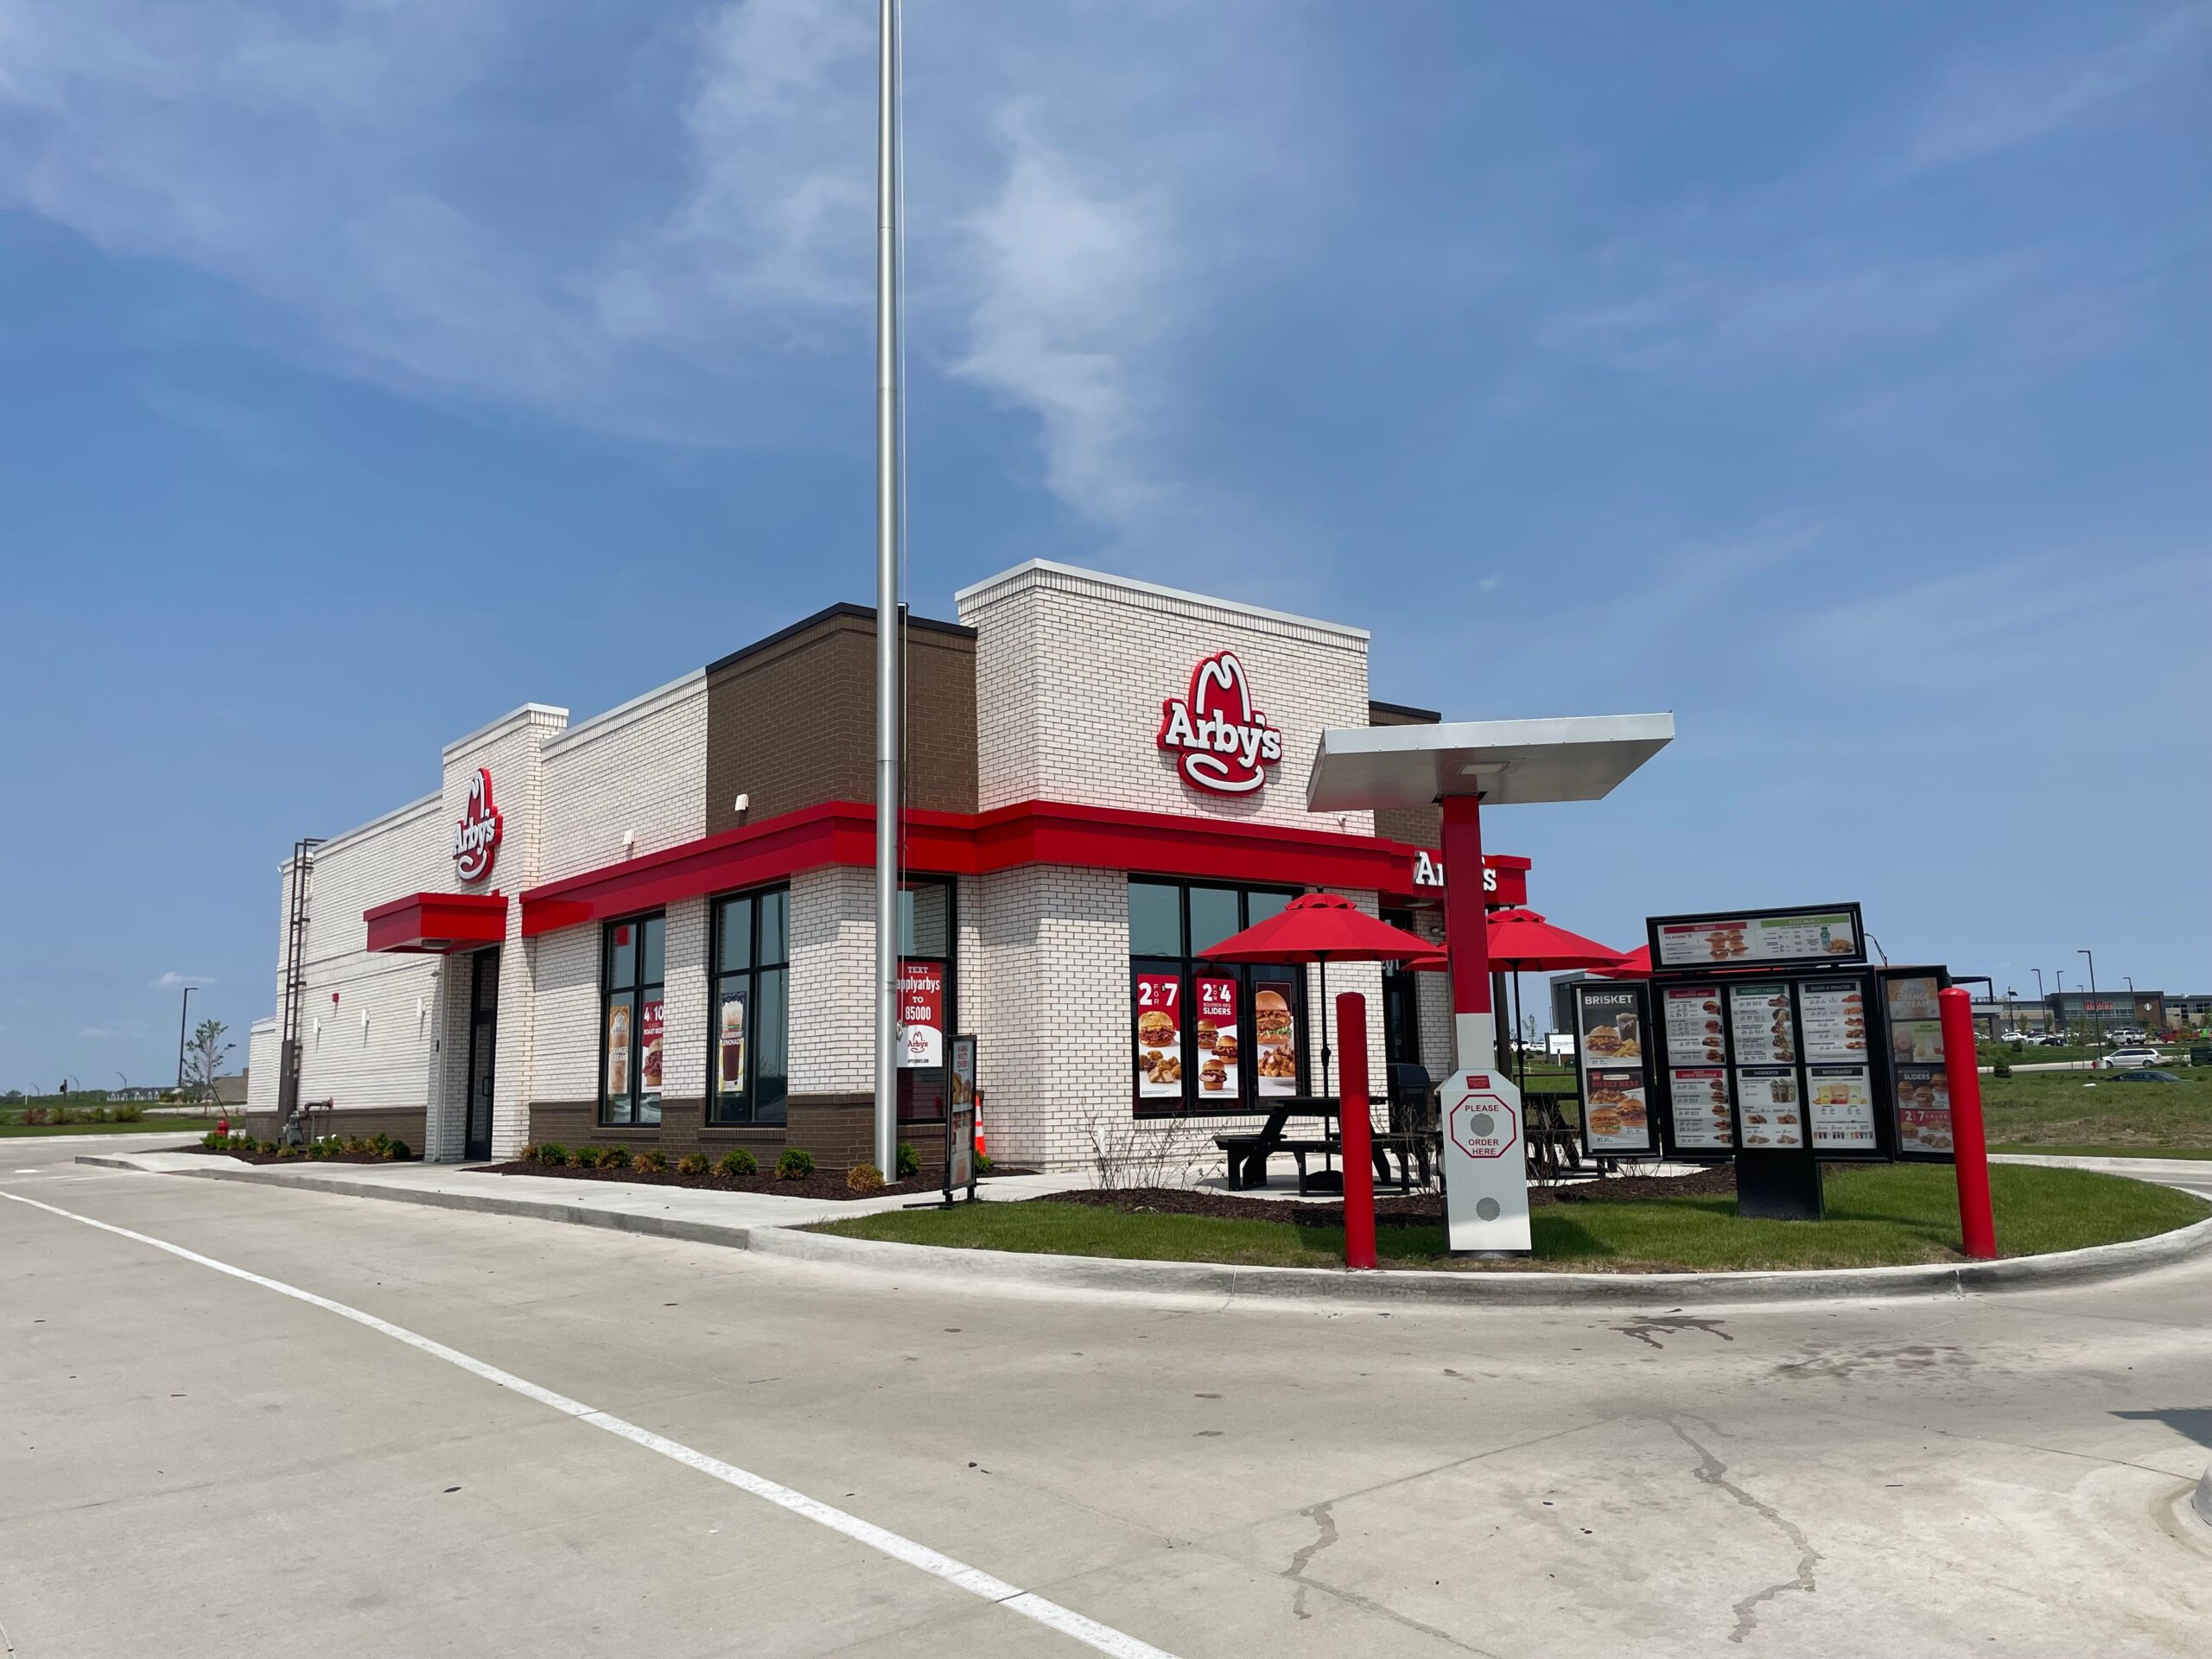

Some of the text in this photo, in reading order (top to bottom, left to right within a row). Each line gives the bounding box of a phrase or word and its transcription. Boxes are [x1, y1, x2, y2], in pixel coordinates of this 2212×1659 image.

[1166, 702, 1281, 767] Arby's
[452, 808, 495, 855] Arby's
[1139, 982, 1152, 1005] 2
[1203, 984, 1213, 1001] 2
[1585, 995, 1633, 1005] BRISKET
[905, 1006, 931, 1020] 85000
[907, 1039, 929, 1049] Arby's
